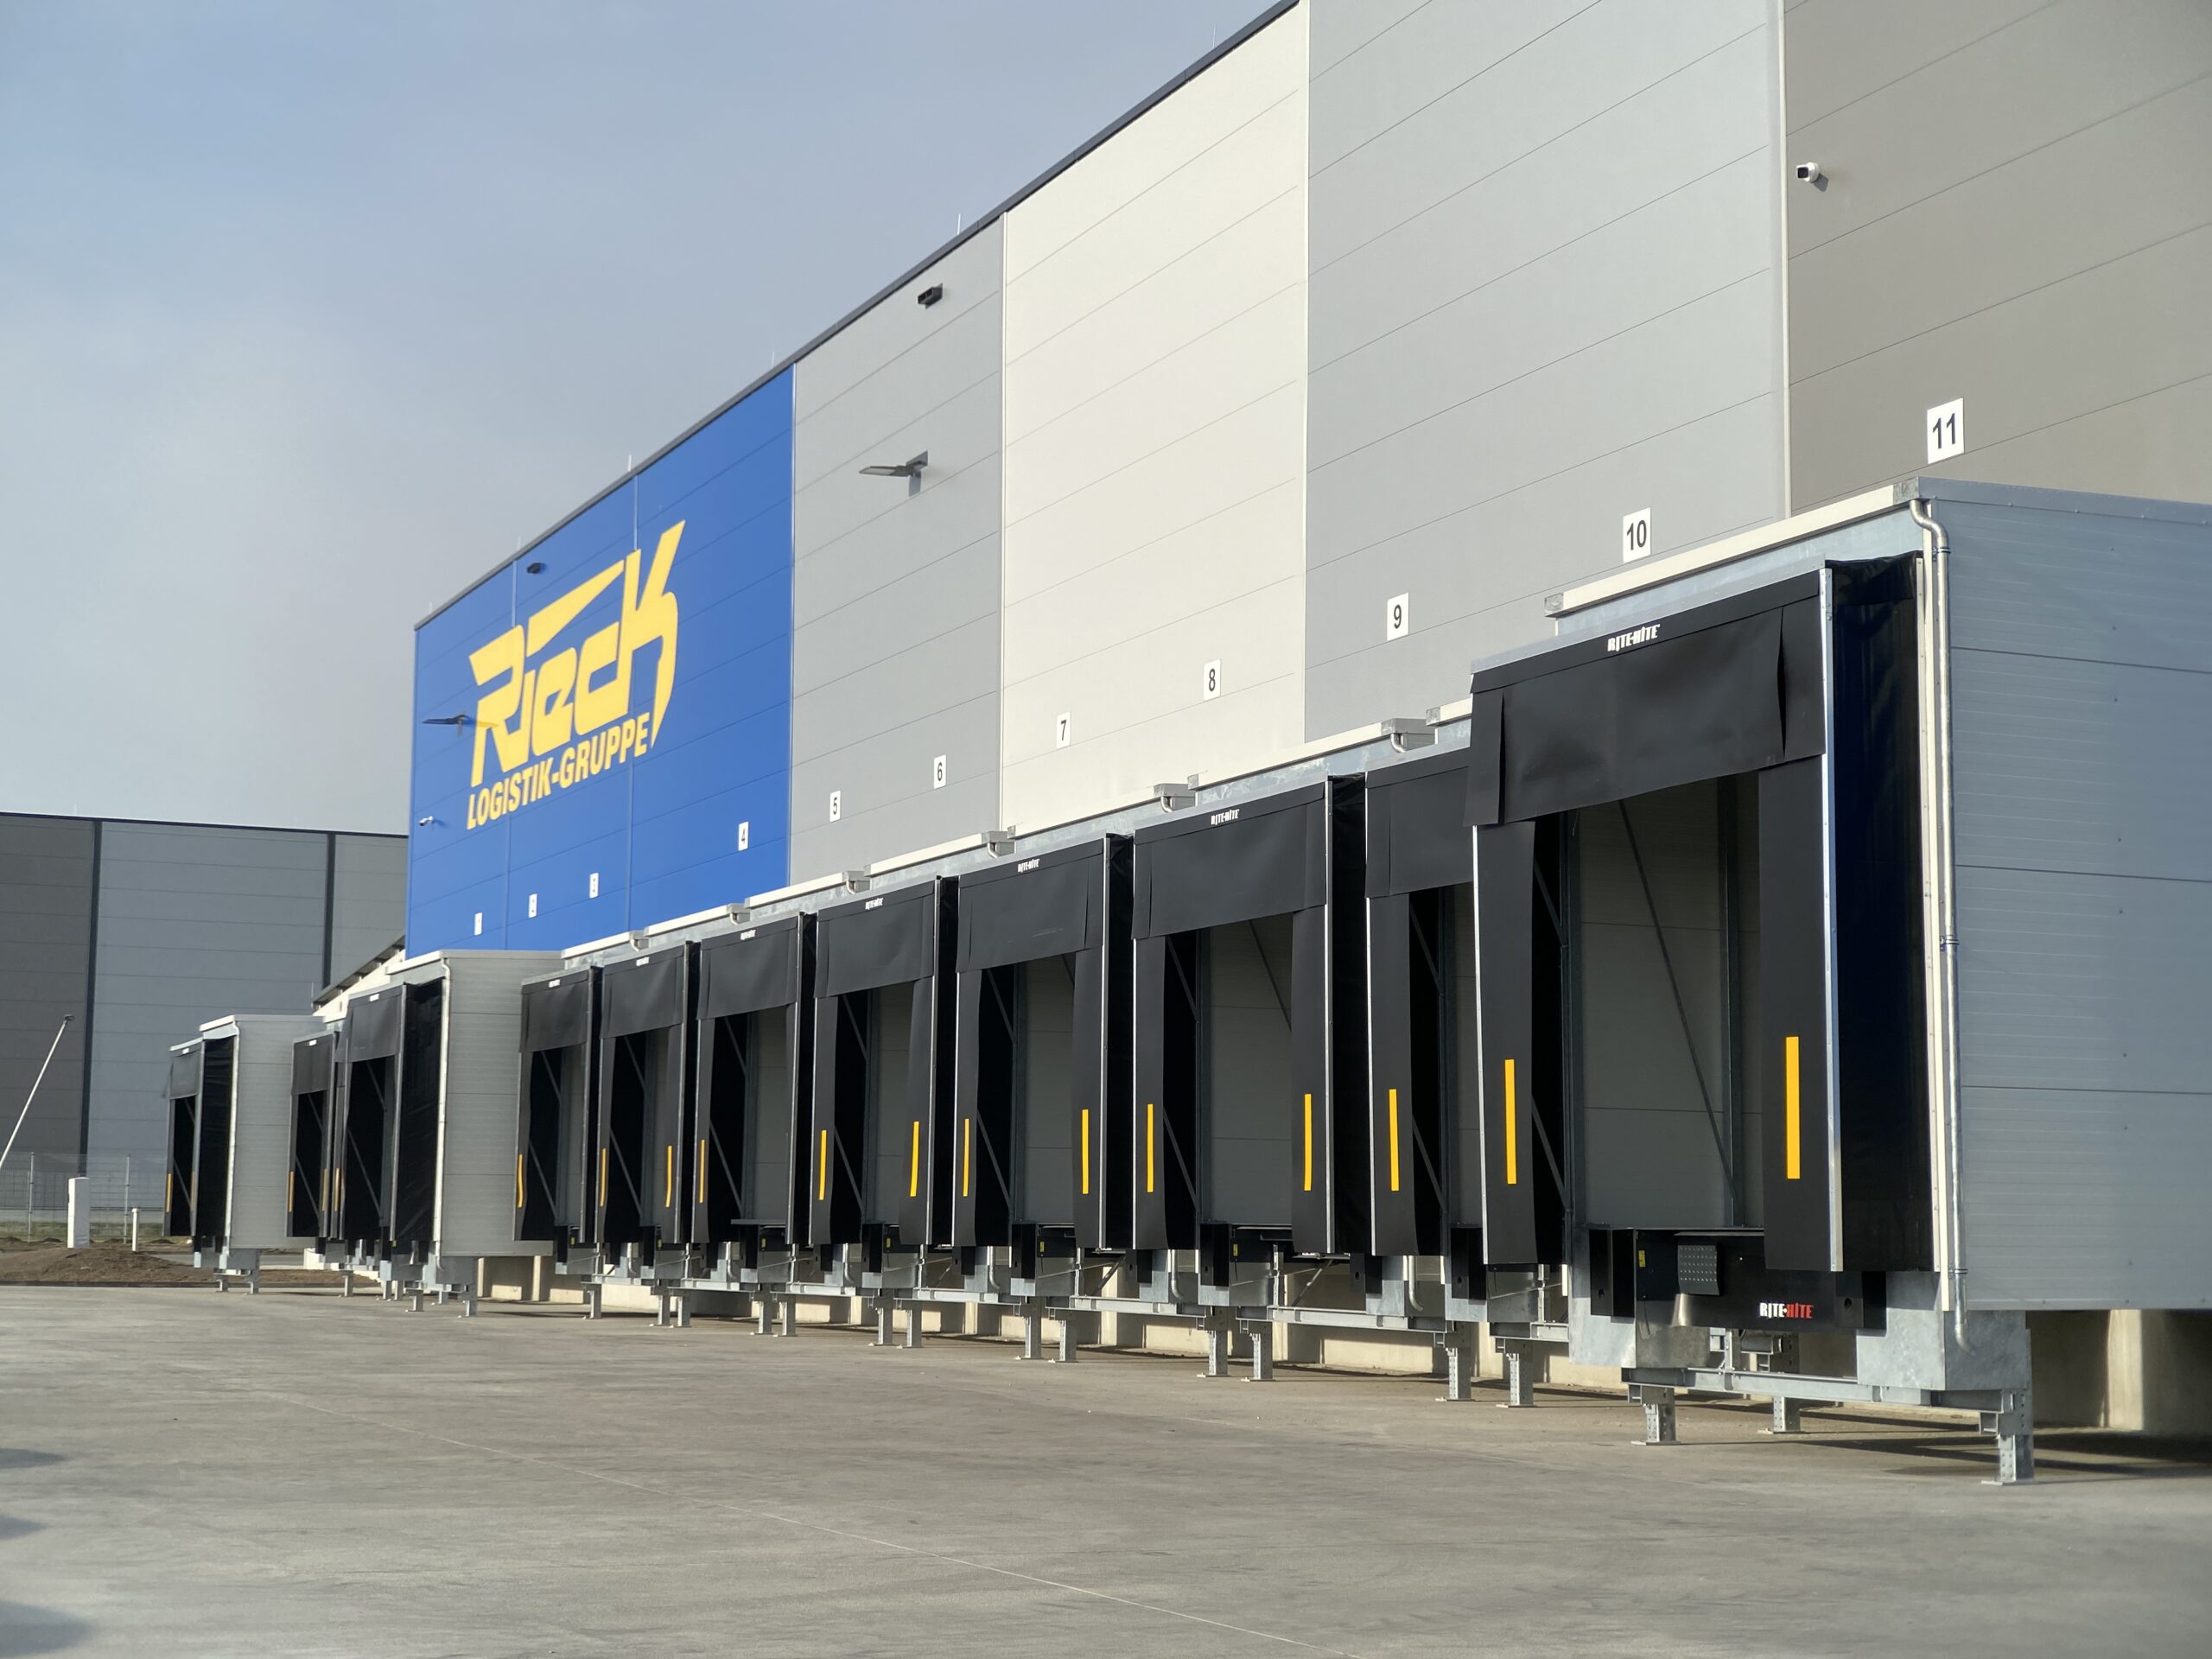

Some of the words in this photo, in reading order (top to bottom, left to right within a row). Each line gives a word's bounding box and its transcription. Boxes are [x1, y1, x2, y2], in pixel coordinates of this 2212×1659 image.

[1932, 412, 1956, 449] 11
[1626, 519, 1647, 550] 10
[1393, 604, 1402, 629] 9
[1208, 668, 1216, 692] 8
[1060, 719, 1067, 741] 7
[467, 713, 651, 830] LOGISTIK-GRUPPE
[936, 761, 943, 782] 6
[832, 797, 838, 816] 5
